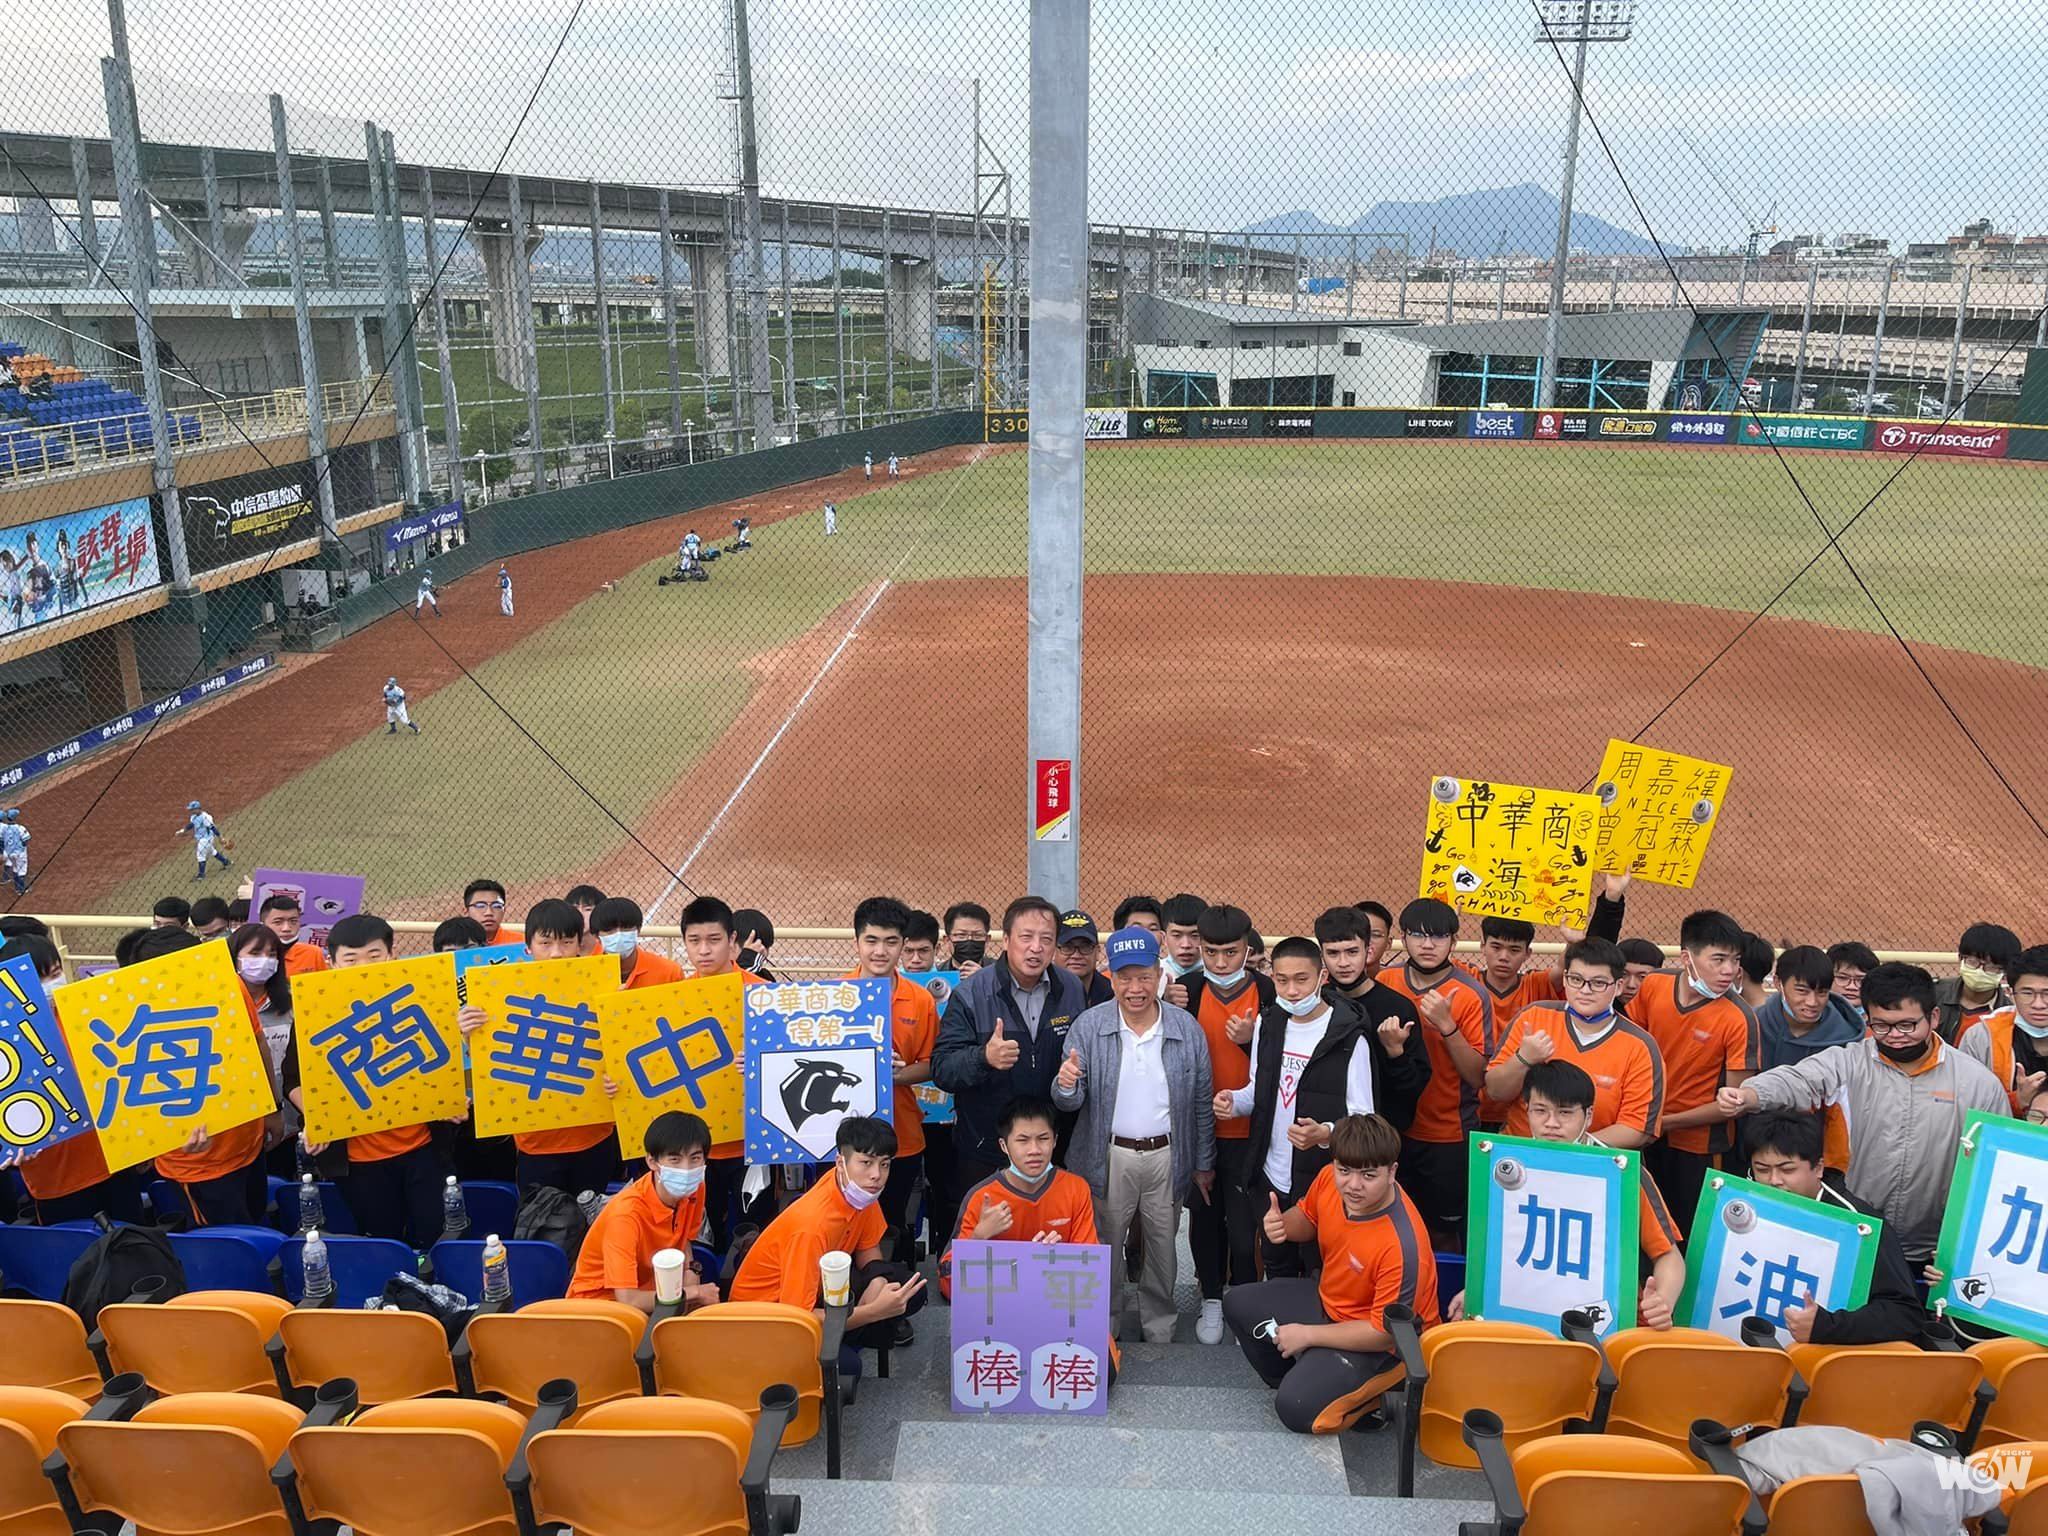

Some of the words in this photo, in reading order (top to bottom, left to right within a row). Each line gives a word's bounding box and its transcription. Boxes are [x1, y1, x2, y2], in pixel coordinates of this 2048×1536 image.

[991, 418, 1028, 433] 330
[1476, 412, 1514, 430] best
[1763, 425, 1818, 439] 中國信託
[1818, 428, 1858, 441] CTBC
[1909, 431, 1996, 449] Transcend
[1047, 767, 1059, 809] 小心飛球
[1610, 751, 1721, 798] 周嘉緯
[1627, 797, 1678, 815] NICE
[1456, 799, 1571, 850] 中華商
[1446, 847, 1466, 860] Go
[1548, 855, 1572, 871] Go
[1485, 858, 1527, 890] 海
[1454, 895, 1522, 917] CHMVS
[1113, 939, 1146, 954] CHMVS
[749, 982, 860, 1015] 中華商海
[310, 983, 450, 1110] 商
[490, 993, 602, 1101] 華
[626, 1016, 734, 1109] 中
[89, 1004, 223, 1130] 海
[1516, 1194, 1593, 1281] 加
[1719, 1251, 1819, 1329] 油
